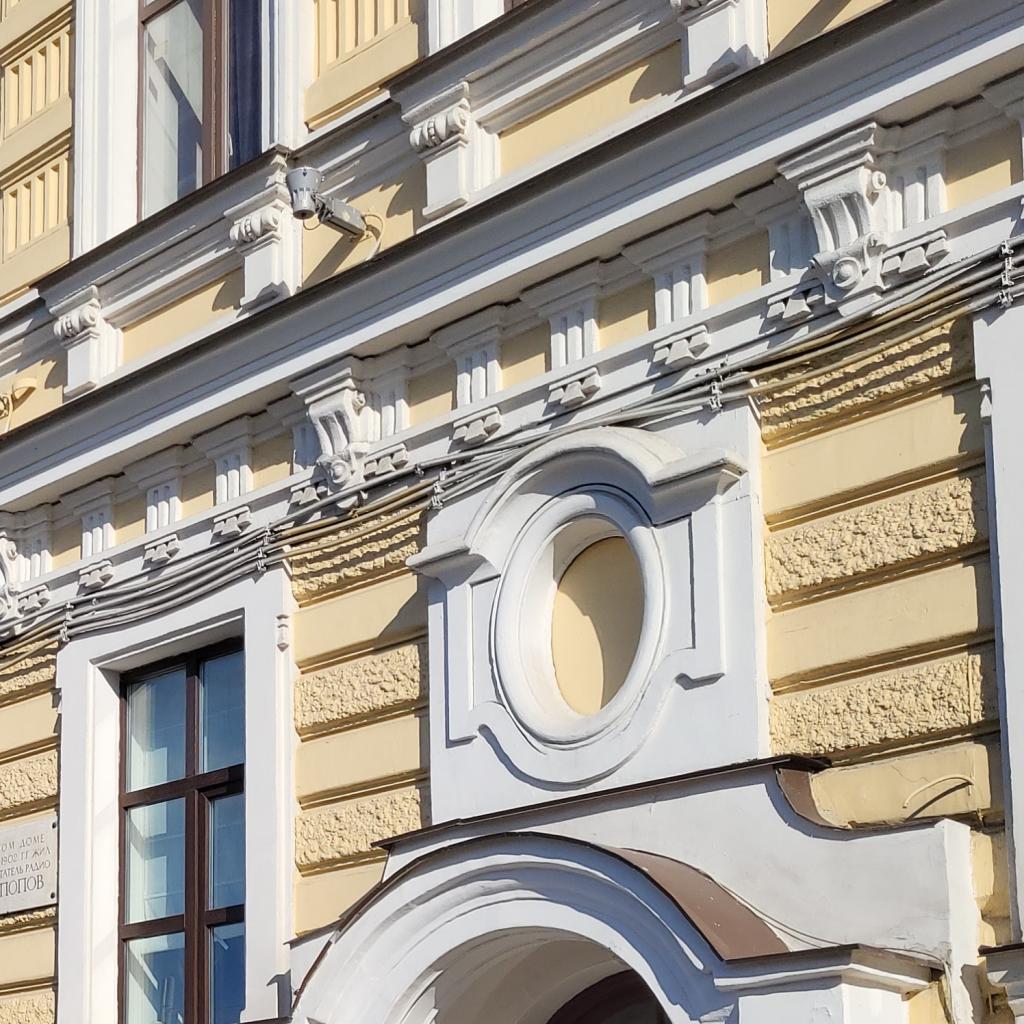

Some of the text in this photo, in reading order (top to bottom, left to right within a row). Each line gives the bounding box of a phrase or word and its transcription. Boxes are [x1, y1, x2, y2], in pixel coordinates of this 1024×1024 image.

[19, 834, 45, 848] ДОМЕ
[32, 846, 51, 858] ЖИЛ
[25, 859, 51, 873] РАДИО
